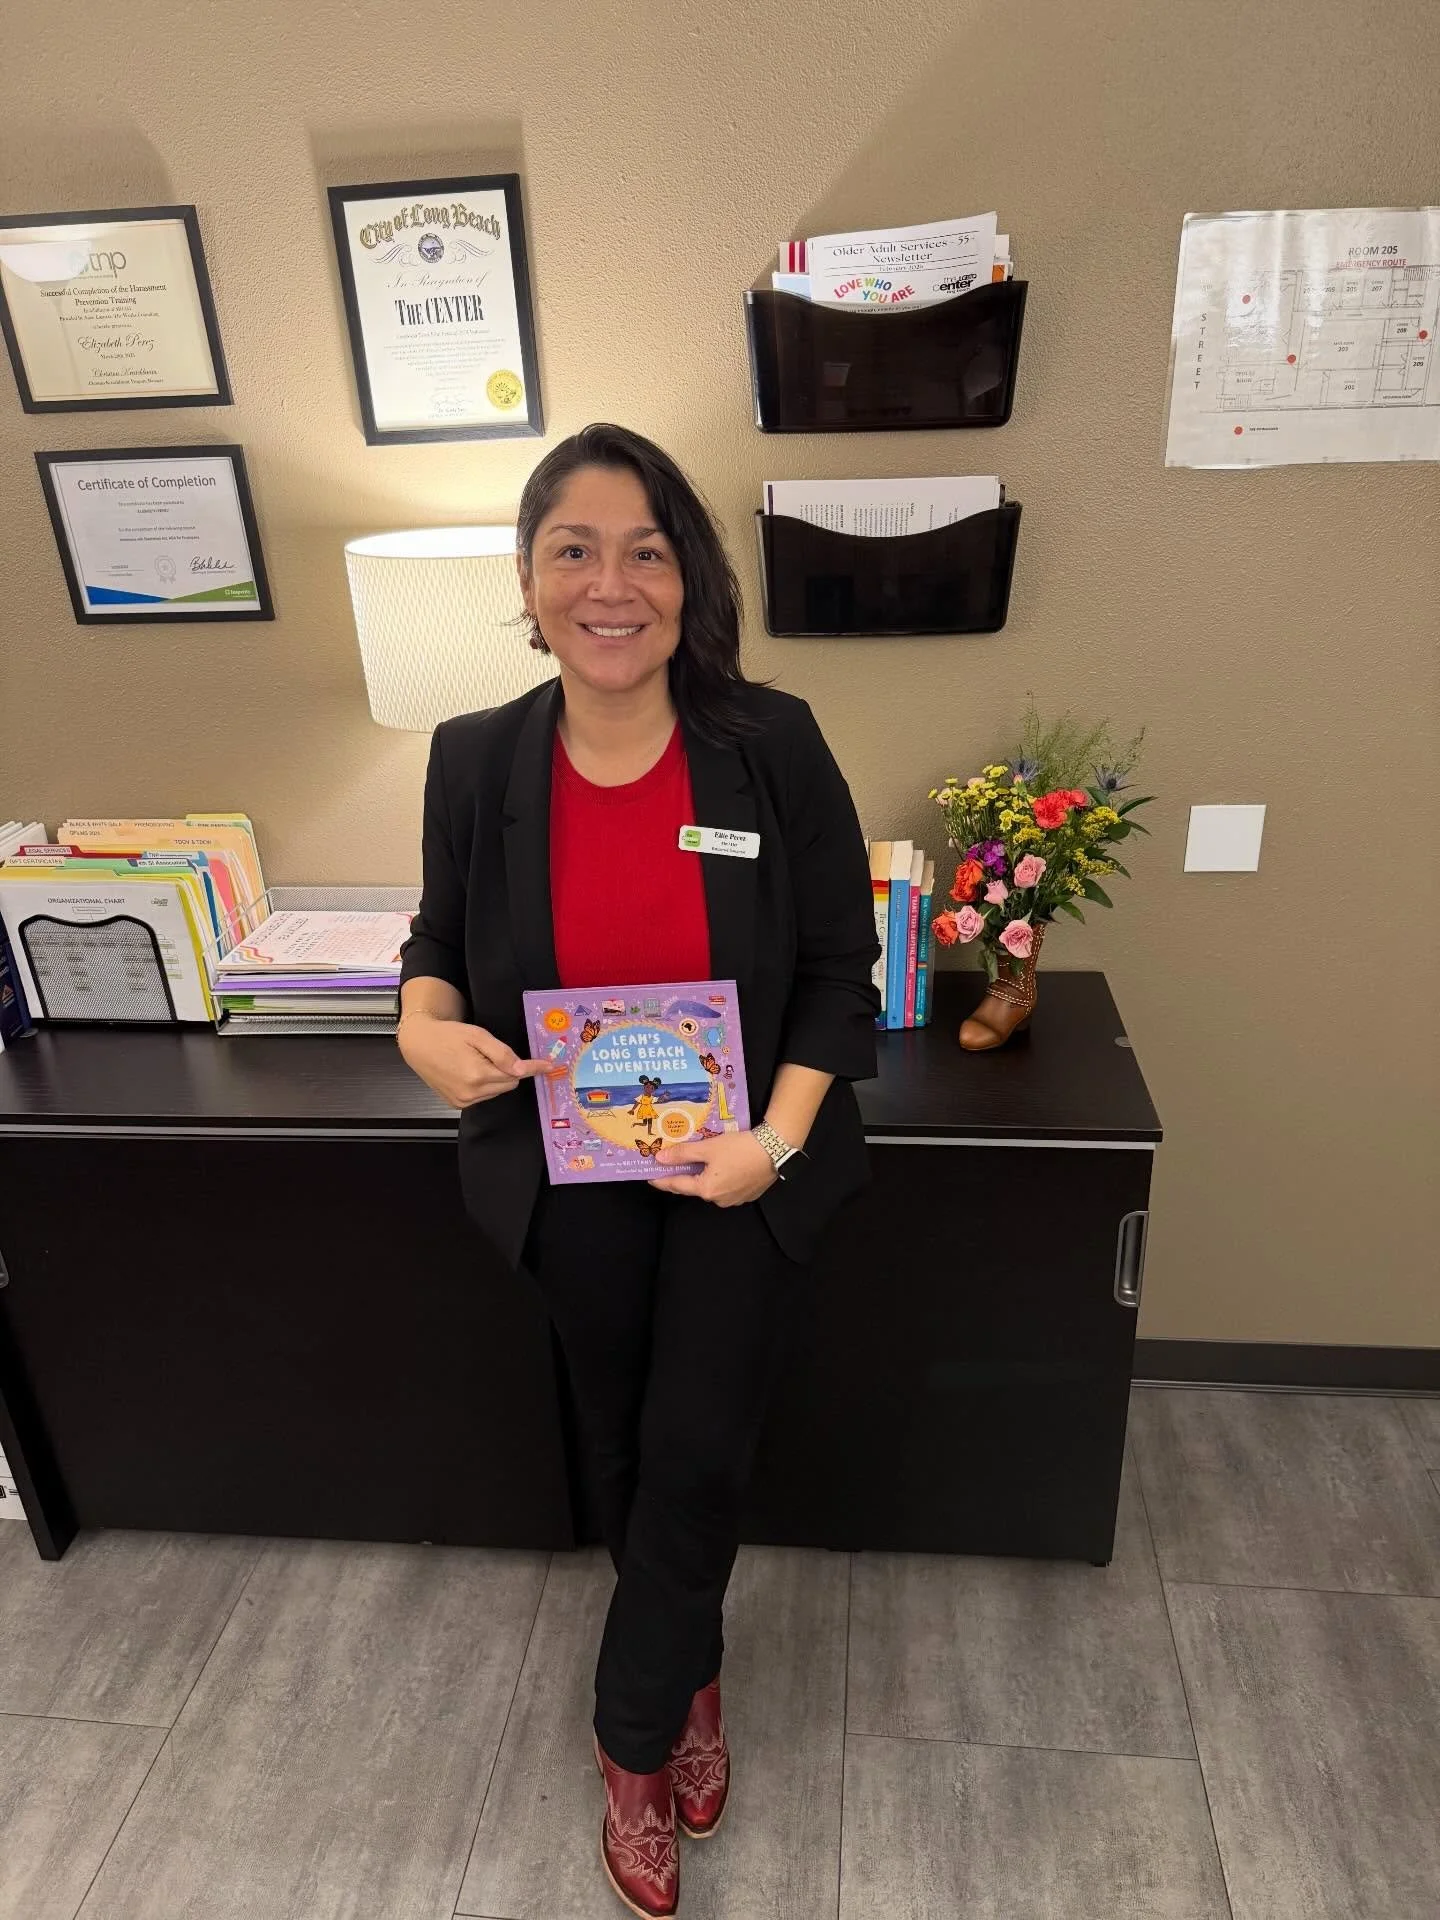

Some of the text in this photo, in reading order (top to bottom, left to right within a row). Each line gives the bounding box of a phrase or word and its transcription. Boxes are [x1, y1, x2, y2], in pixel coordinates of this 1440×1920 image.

[359, 203, 501, 249] City of Long Beach
[832, 246, 865, 257] Older
[868, 243, 897, 254] Adult
[900, 240, 948, 252] Services
[1349, 245, 1398, 256] ROOM 205
[872, 252, 933, 264] Newsletter
[1382, 258, 1407, 267] ROUTE
[40, 288, 72, 298] Successful
[72, 287, 109, 297] Completion
[110, 285, 118, 293] of
[129, 284, 167, 293] Harassment
[833, 277, 892, 300] LOVE WHO
[862, 285, 916, 304] YOU ARE
[75, 296, 137, 306] Prevention Training
[425, 294, 484, 325] CENTER
[77, 333, 155, 353] Elizabeth Perez
[77, 475, 216, 492] Certificate of Completion
[729, 833, 747, 842] Perez
[612, 1033, 661, 1046] LEAH'S
[591, 1045, 684, 1061] LONG BEACH
[594, 1059, 688, 1074] ADVENTURES
